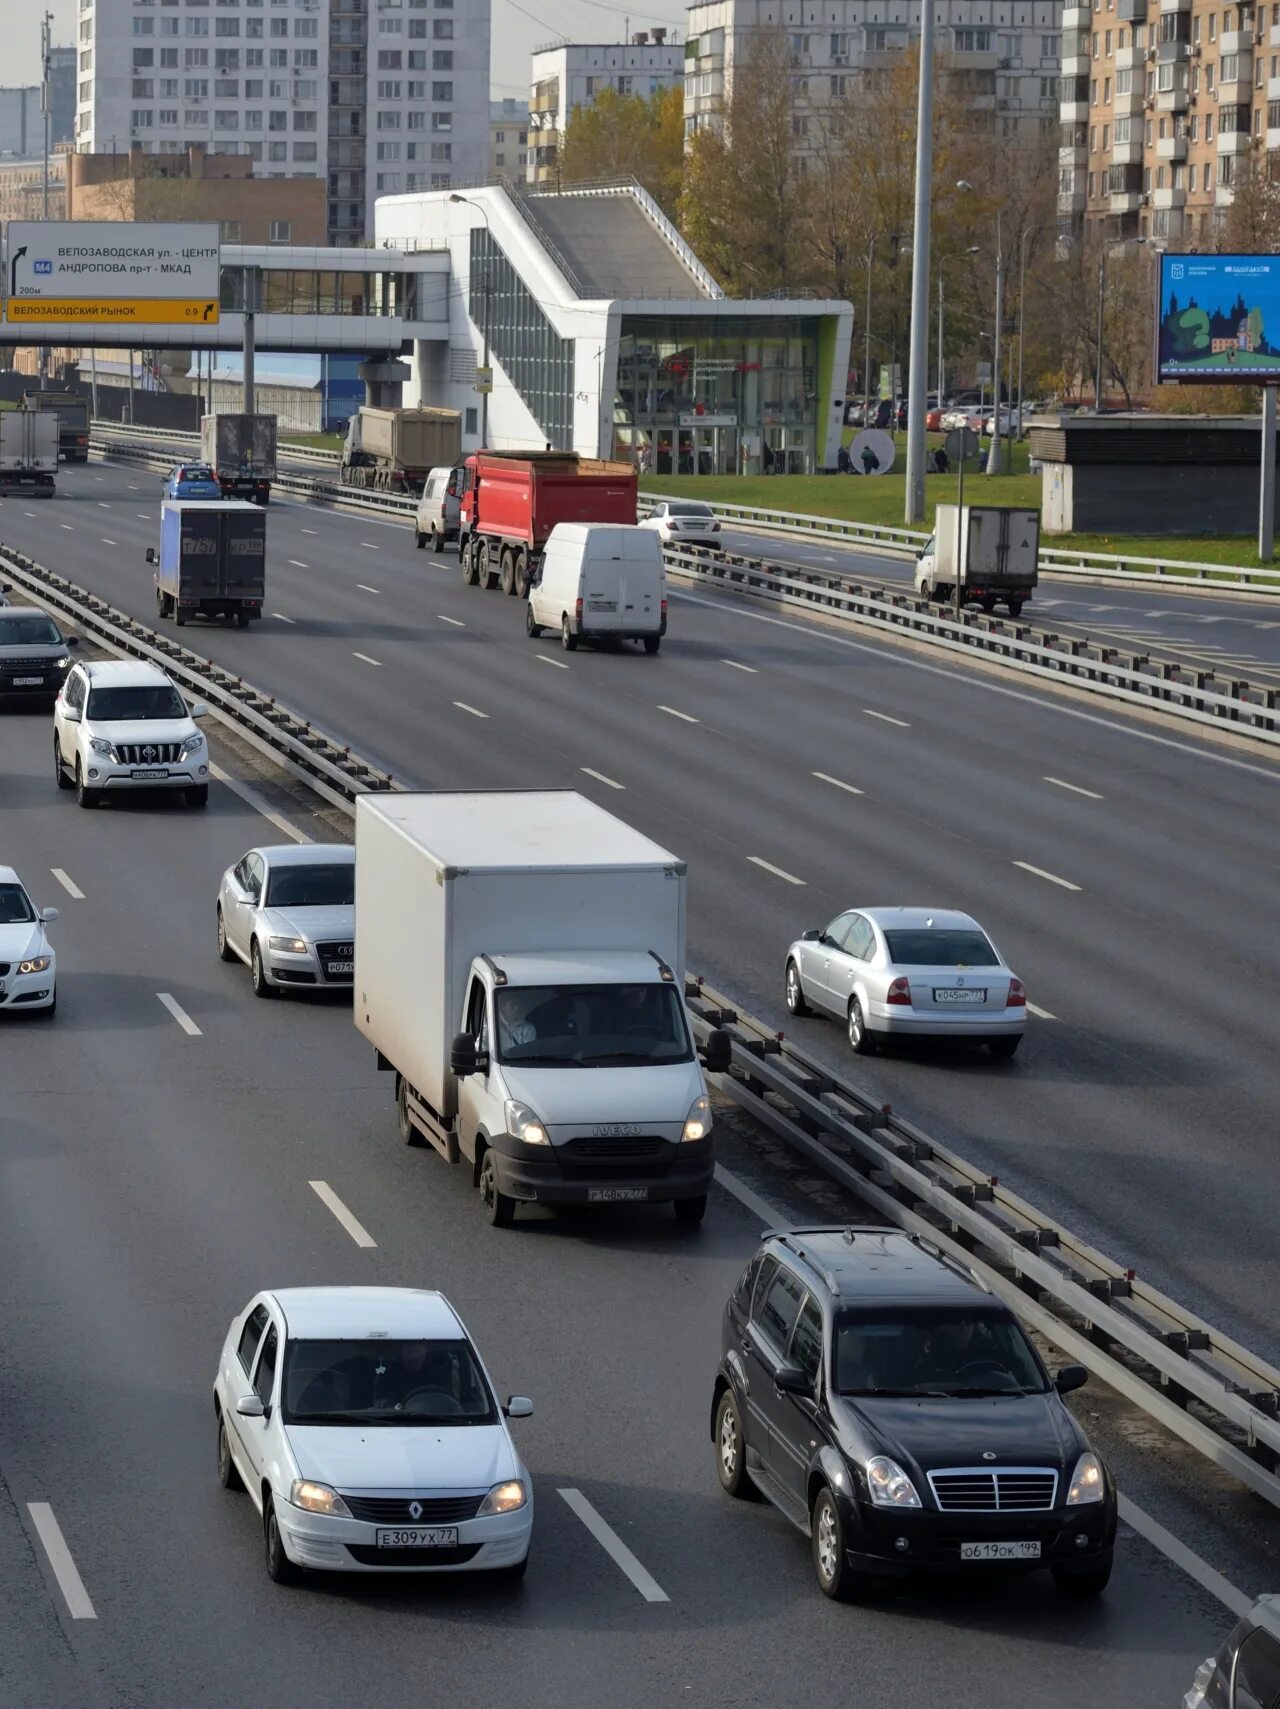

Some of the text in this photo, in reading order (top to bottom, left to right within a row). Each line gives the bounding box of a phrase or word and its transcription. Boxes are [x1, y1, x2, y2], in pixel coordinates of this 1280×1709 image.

[58, 248, 155, 258] ВЕЛОЗАВОДСКАЯ
[157, 250, 173, 259] ул.
[182, 249, 217, 259] ЦЕНТР
[35, 263, 51, 272] М4
[58, 264, 127, 273] АНДРОПОВА
[129, 266, 151, 274] пр-т
[160, 264, 191, 274] МКАД
[19, 287, 41, 295] 200м
[14, 305, 135, 316] ВЕЛОЗАВОДСКИЙ РЫНОК
[185, 308, 198, 316] 0.9
[184, 538, 216, 554] Т757
[592, 1124, 641, 1137] IVECO
[382, 1529, 453, 1545] Е309УХ 77
[964, 1542, 1037, 1558] О619ОК 199
